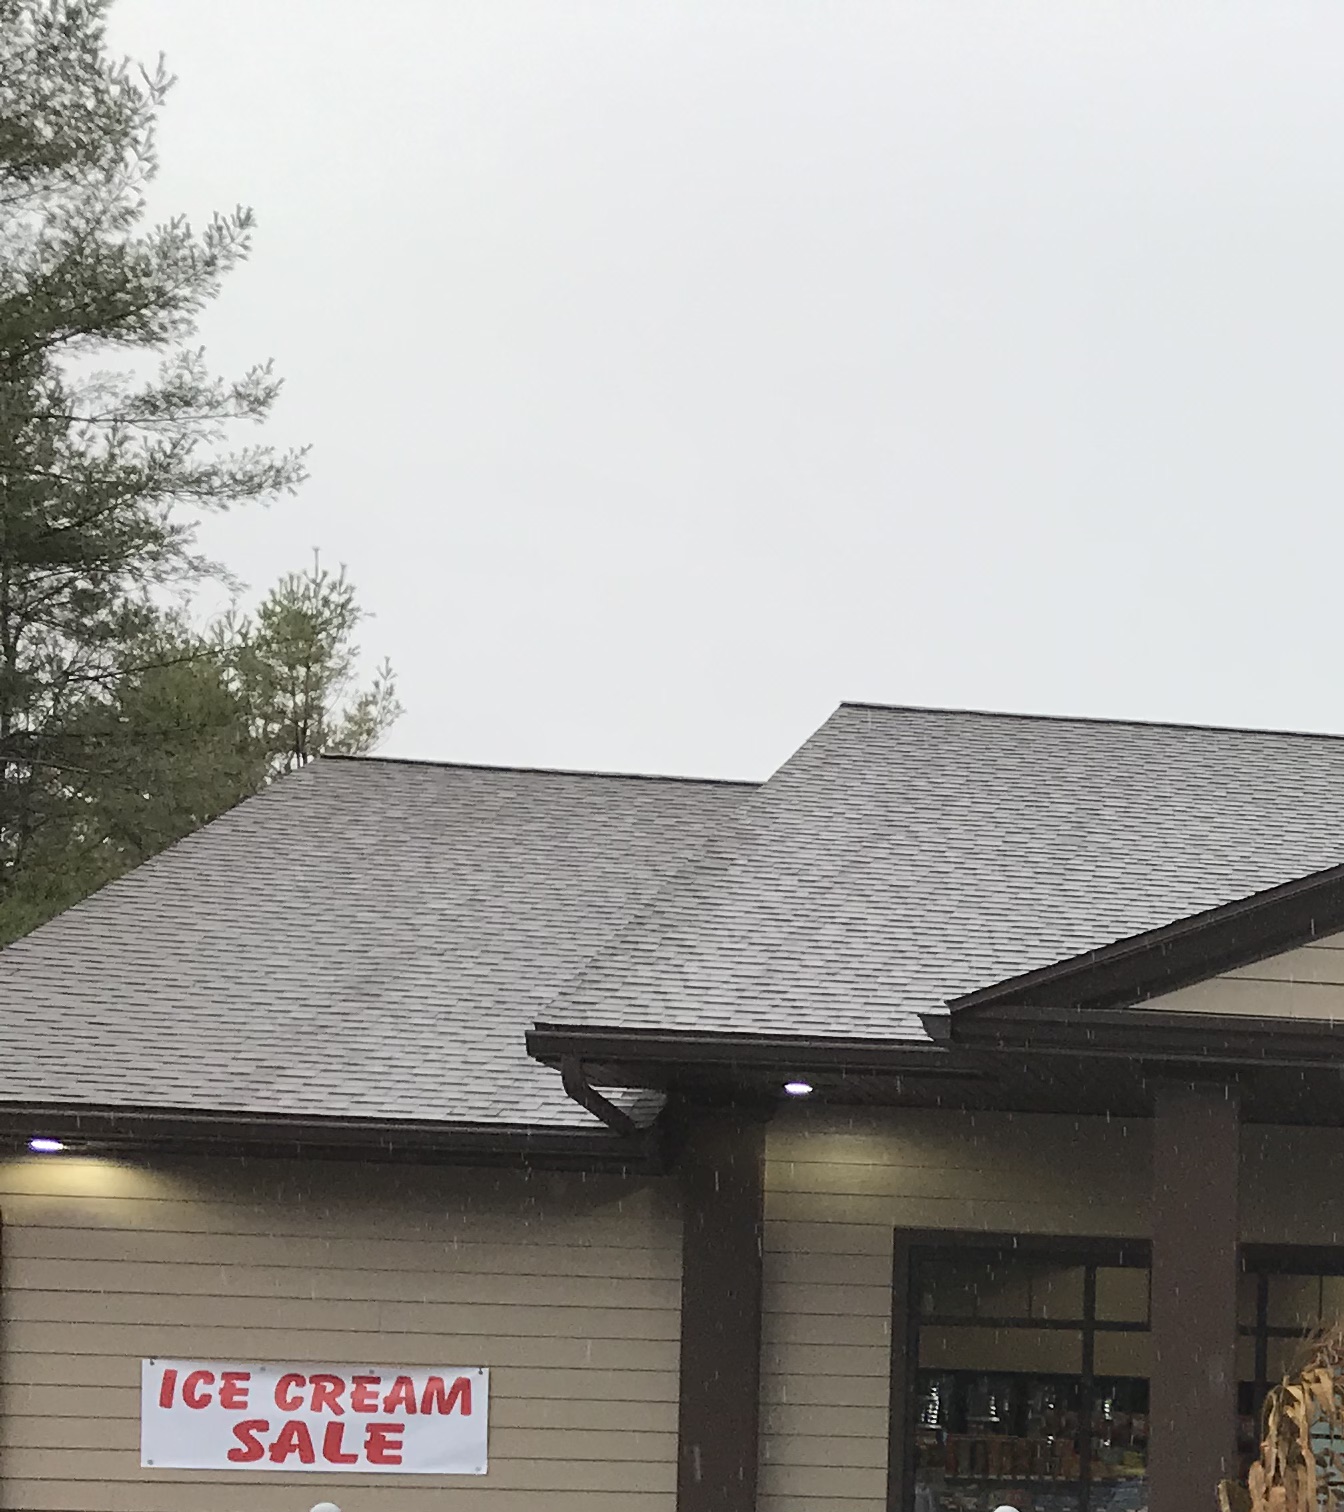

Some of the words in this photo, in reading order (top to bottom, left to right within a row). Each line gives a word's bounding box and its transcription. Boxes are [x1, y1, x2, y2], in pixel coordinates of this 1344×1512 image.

[160, 1369, 250, 1410] ICE
[275, 1373, 472, 1416] CREAM
[227, 1419, 405, 1464] SALE
